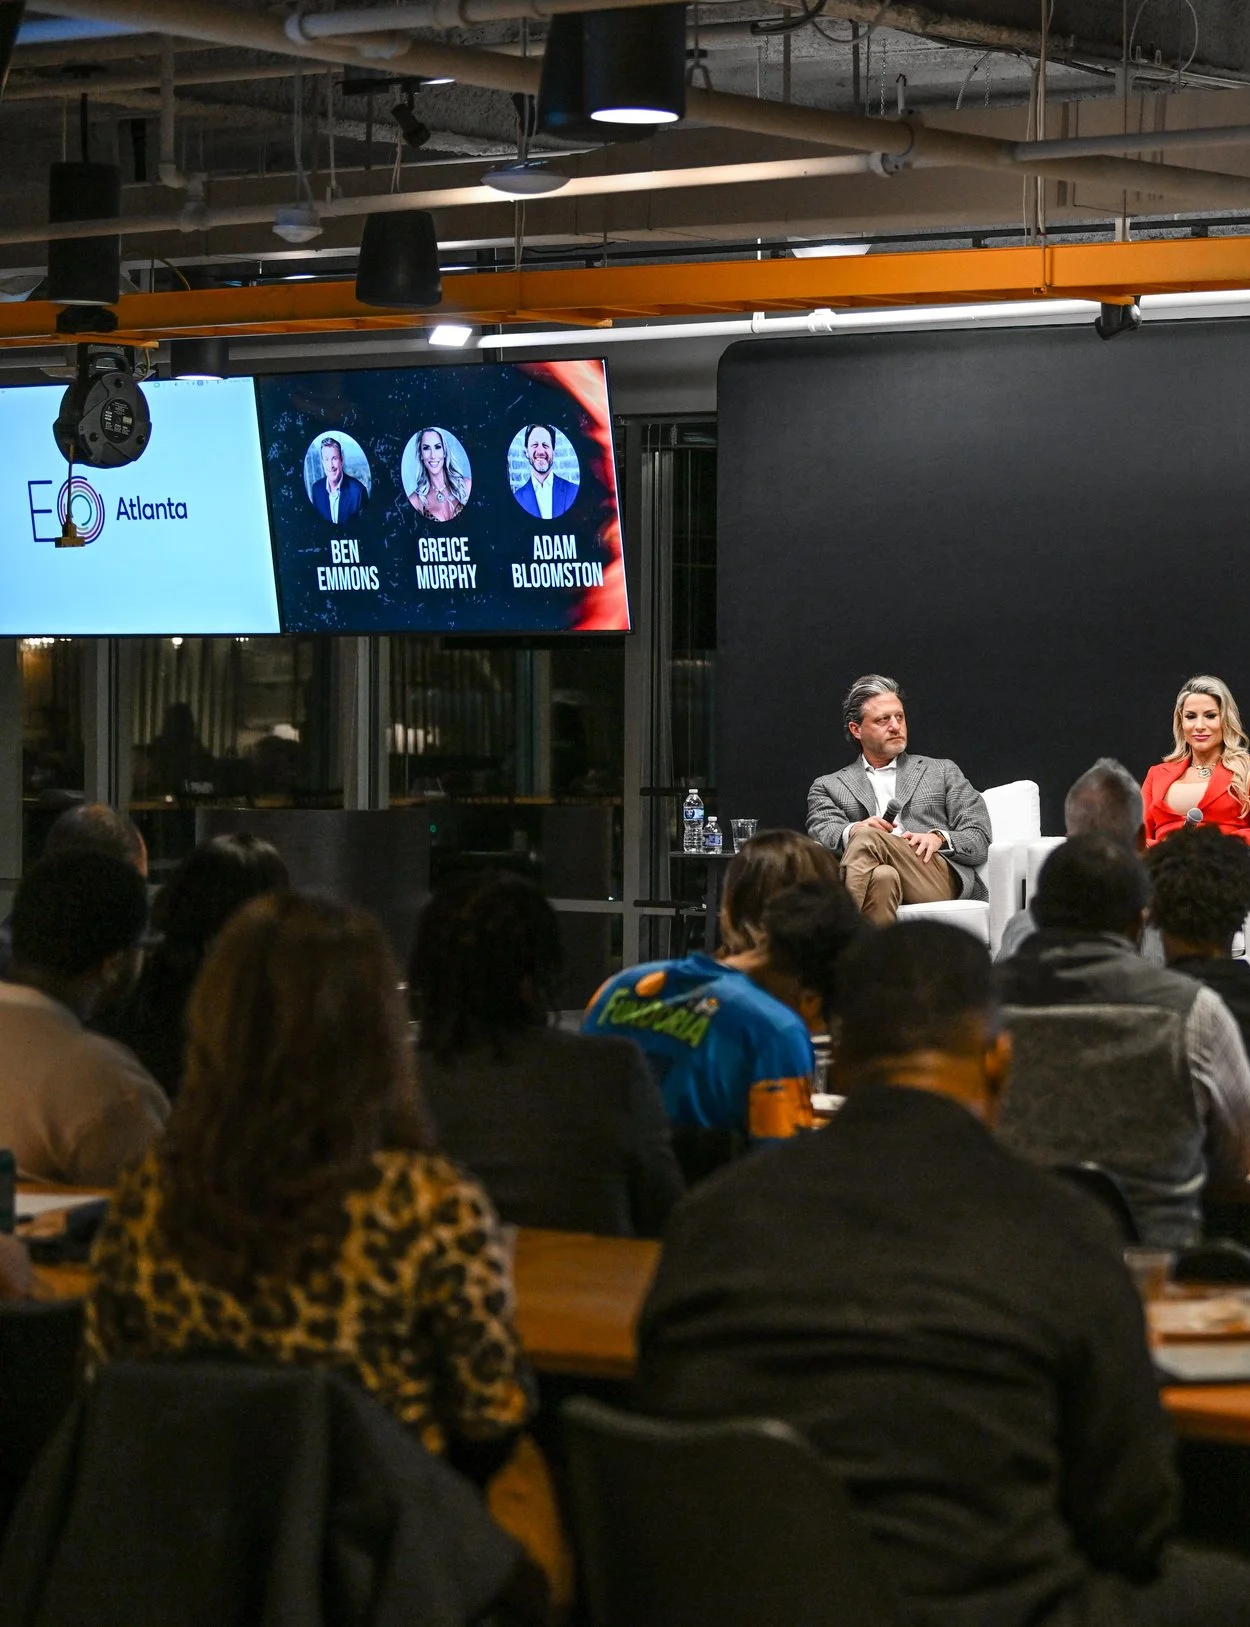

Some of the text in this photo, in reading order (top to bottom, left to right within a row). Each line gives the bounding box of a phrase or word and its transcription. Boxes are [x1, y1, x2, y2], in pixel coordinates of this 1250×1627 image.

[28, 476, 188, 545] EO Atlanta
[330, 539, 360, 564] BEN
[418, 537, 471, 562] GREICE
[533, 534, 577, 561] ADAM
[317, 565, 380, 591] EMMONS
[415, 564, 477, 590] MURPHY
[511, 562, 604, 588] BLOOMSTON
